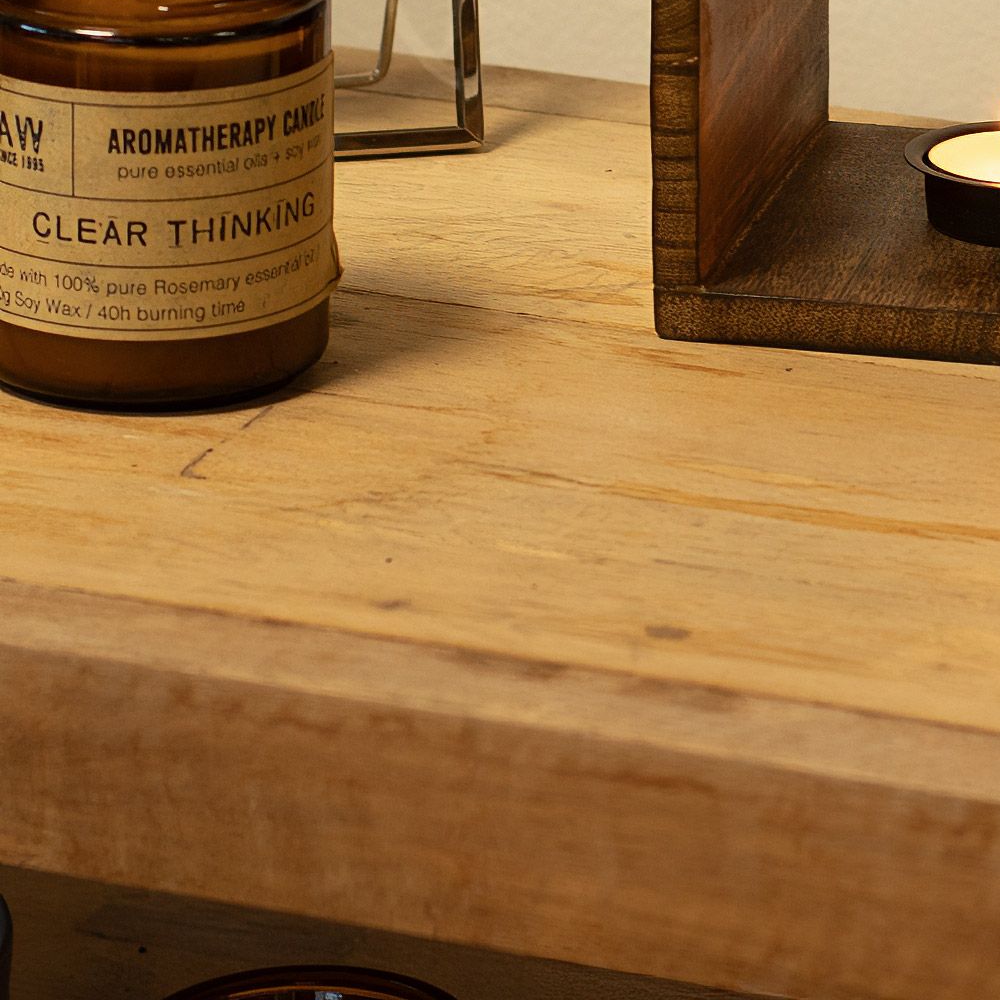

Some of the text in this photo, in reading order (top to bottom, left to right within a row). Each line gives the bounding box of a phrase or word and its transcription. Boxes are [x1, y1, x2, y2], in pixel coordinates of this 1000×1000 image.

[107, 114, 277, 155] AROMATHERAPY
[117, 164, 158, 181] pure
[165, 157, 239, 179] essential
[243, 152, 268, 171] oils
[32, 192, 315, 248] CLEAR THINKING
[20, 268, 47, 287] with
[54, 274, 100, 294] 100%
[106, 283, 147, 297] pure
[154, 276, 240, 295] Rosemary
[245, 252, 302, 285] essential
[15, 290, 41, 314] Soy
[45, 299, 82, 318] Wax
[97, 305, 131, 321] 40h
[137, 305, 206, 323] burning
[212, 300, 245, 317] time
